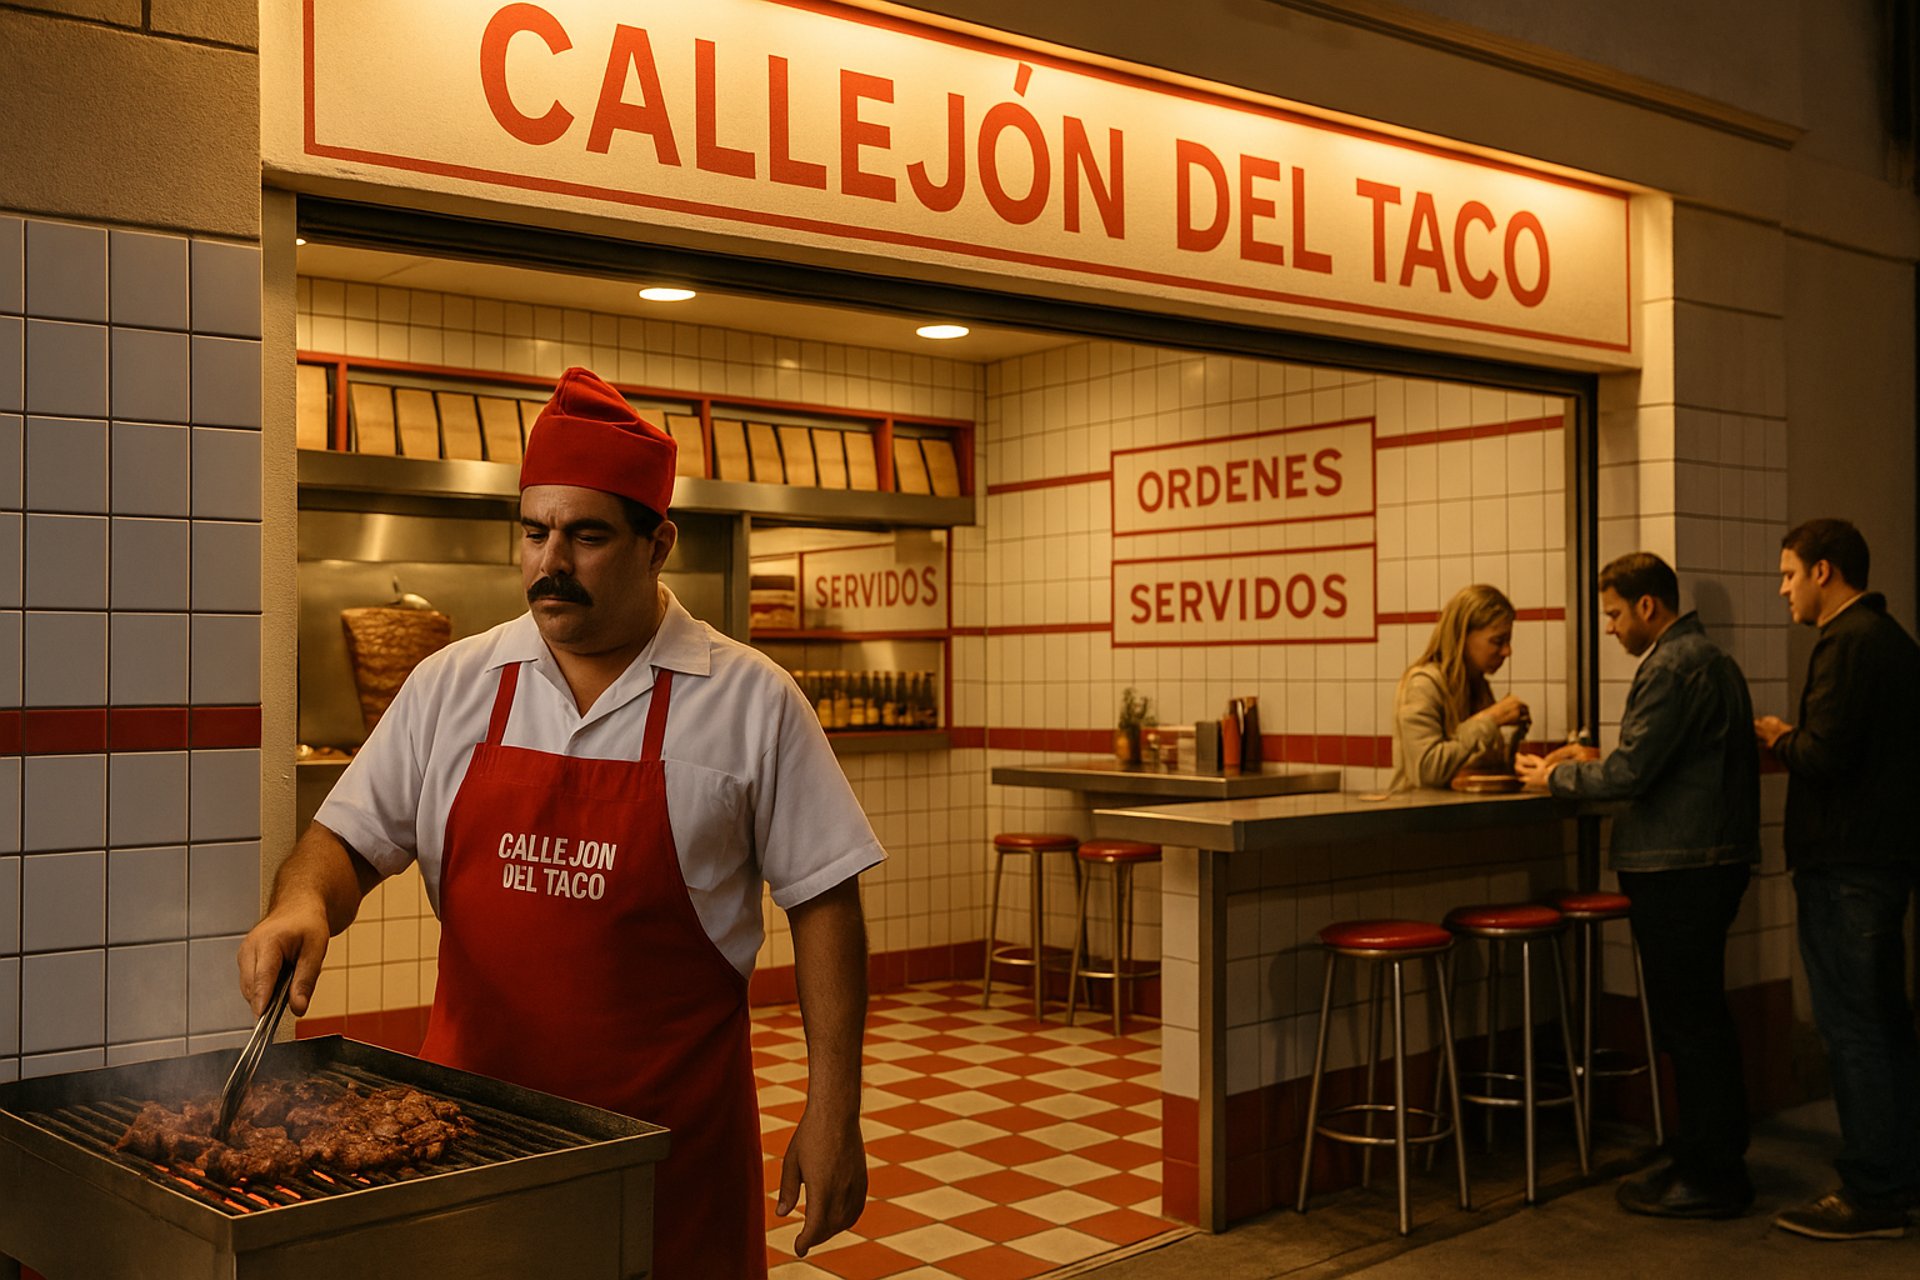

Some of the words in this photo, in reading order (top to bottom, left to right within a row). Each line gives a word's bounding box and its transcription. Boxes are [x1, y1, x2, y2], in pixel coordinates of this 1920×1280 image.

[480, 2, 1125, 239] CALLEJÓN
[1176, 138, 1333, 275] DEL
[1356, 178, 1550, 308] TACO
[1137, 448, 1343, 513] ORDENES
[815, 566, 938, 609] SERVIDOS
[1130, 573, 1347, 624] SERVIDOS
[503, 863, 537, 893] DEL
[543, 868, 605, 900] TACO
